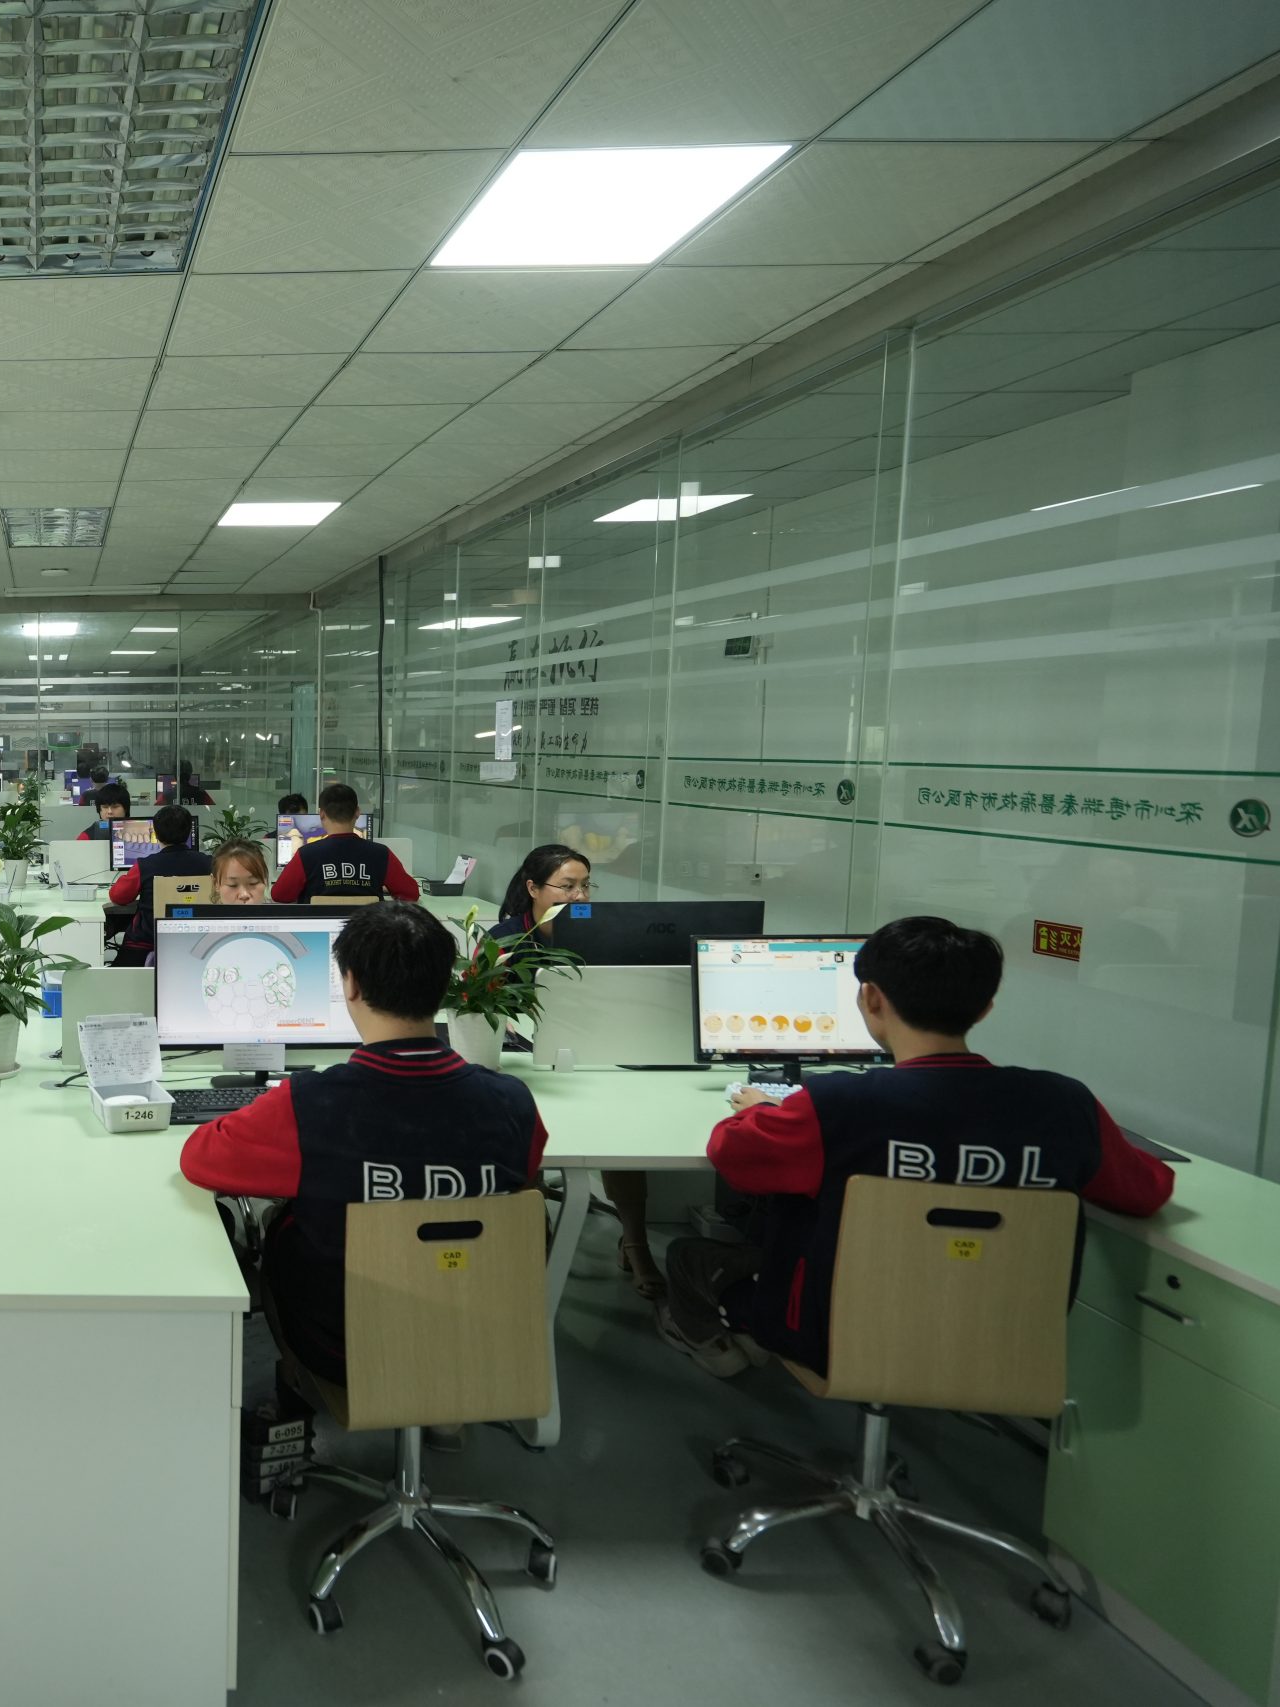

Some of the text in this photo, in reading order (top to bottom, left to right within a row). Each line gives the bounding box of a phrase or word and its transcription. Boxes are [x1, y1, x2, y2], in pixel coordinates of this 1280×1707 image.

[322, 862, 371, 880] BDL
[124, 1110, 154, 1120] 1-246
[887, 1139, 1058, 1189] BDL
[363, 1161, 510, 1204] BDL
[954, 1240, 976, 1249] CAD
[274, 1424, 303, 1440] 6-095
[270, 1443, 297, 1456] 7-275
